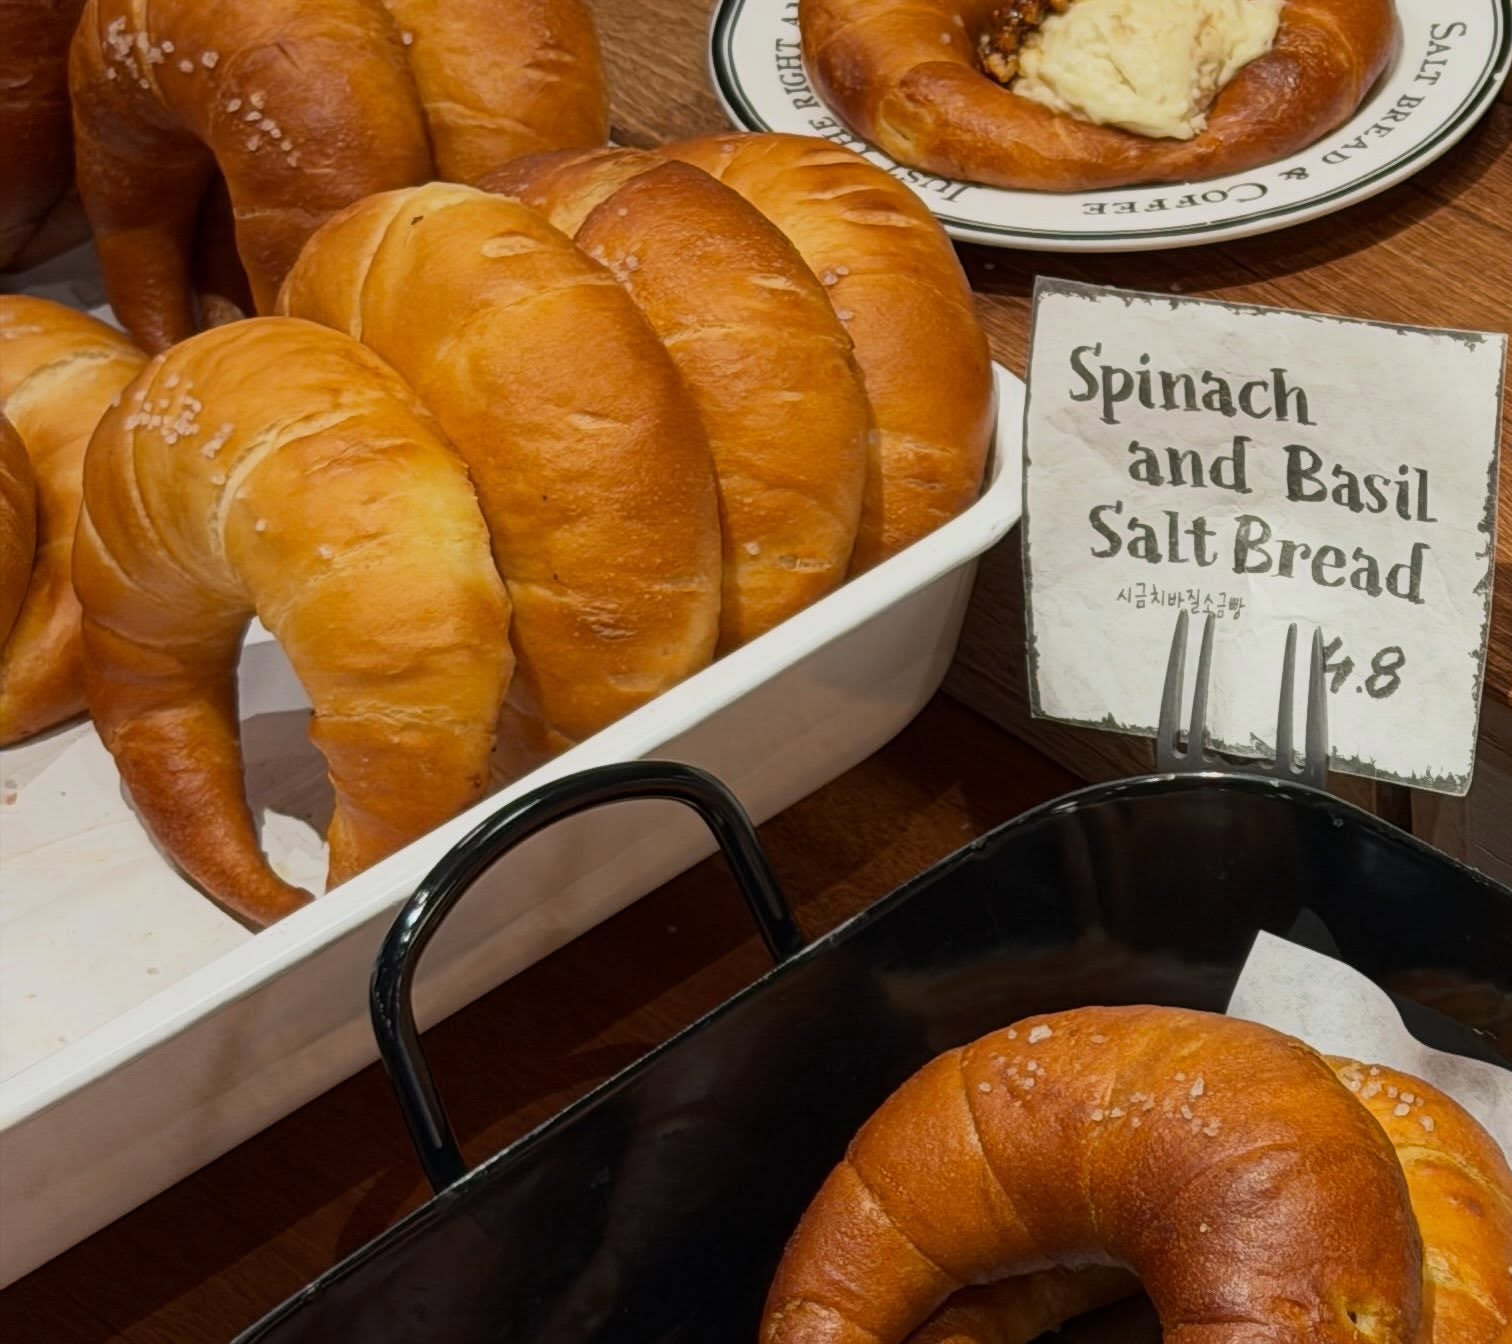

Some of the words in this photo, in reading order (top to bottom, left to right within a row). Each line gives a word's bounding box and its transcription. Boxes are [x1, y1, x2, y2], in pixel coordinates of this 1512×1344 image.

[775, 38, 821, 110] RIGHT
[1414, 21, 1467, 86] SALT
[1321, 94, 1426, 165] BREAD
[1082, 182, 1268, 216] COFFEE
[1278, 167, 1310, 181] &
[1068, 342, 1318, 426] Spinach
[1128, 435, 1254, 494] and
[1282, 444, 1438, 523] Basil
[1088, 500, 1218, 568] Salt
[1231, 514, 1432, 605] Bread
[1116, 582, 1246, 620] 시금치바질소금빵
[1320, 636, 1407, 699] 4.8
